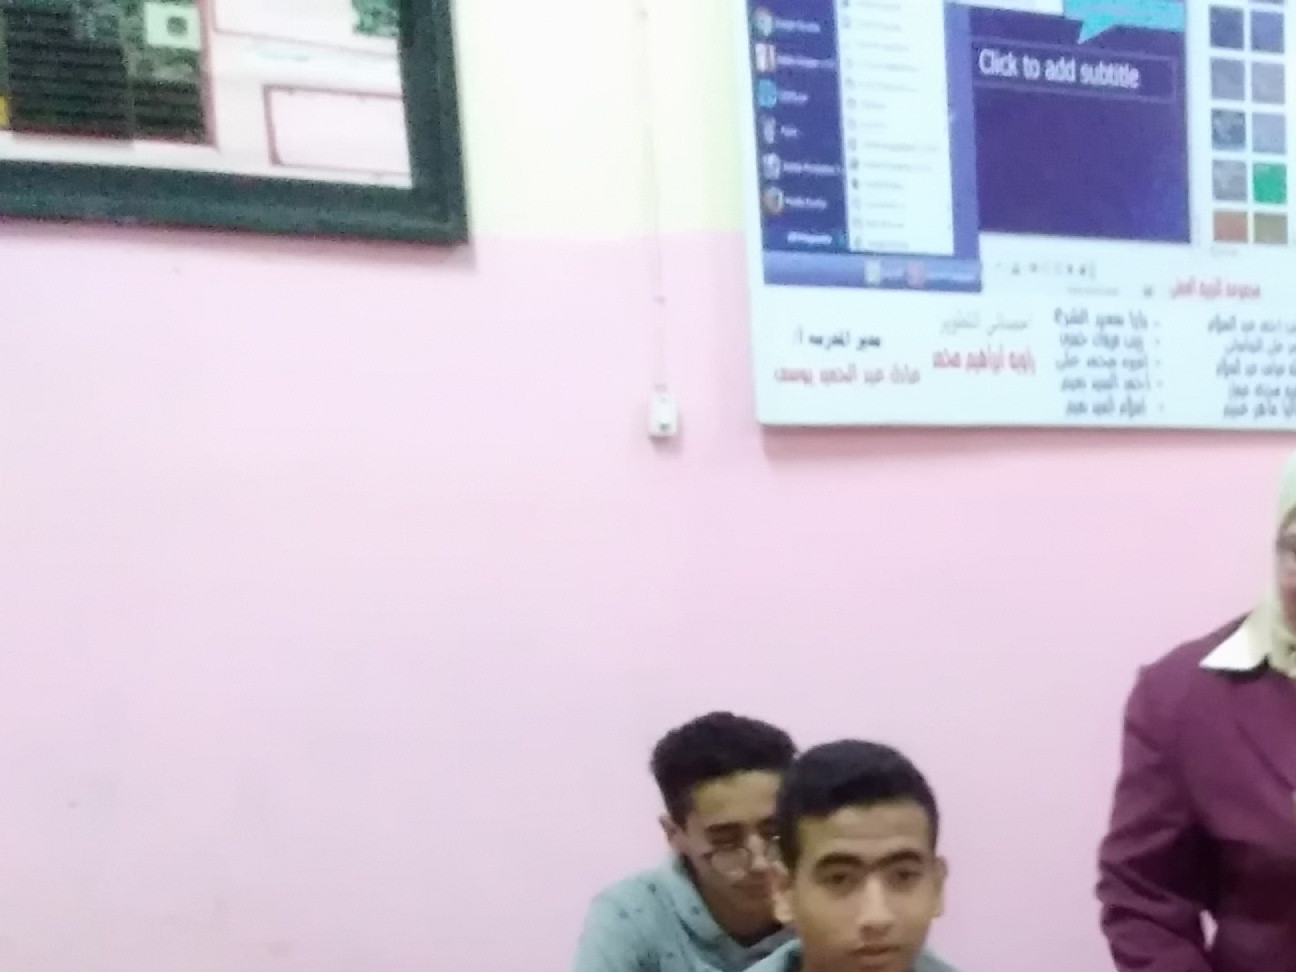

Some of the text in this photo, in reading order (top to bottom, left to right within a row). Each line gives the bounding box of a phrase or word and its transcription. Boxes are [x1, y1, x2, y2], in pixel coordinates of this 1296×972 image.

[979, 48, 1140, 89] Click to add subtitle
